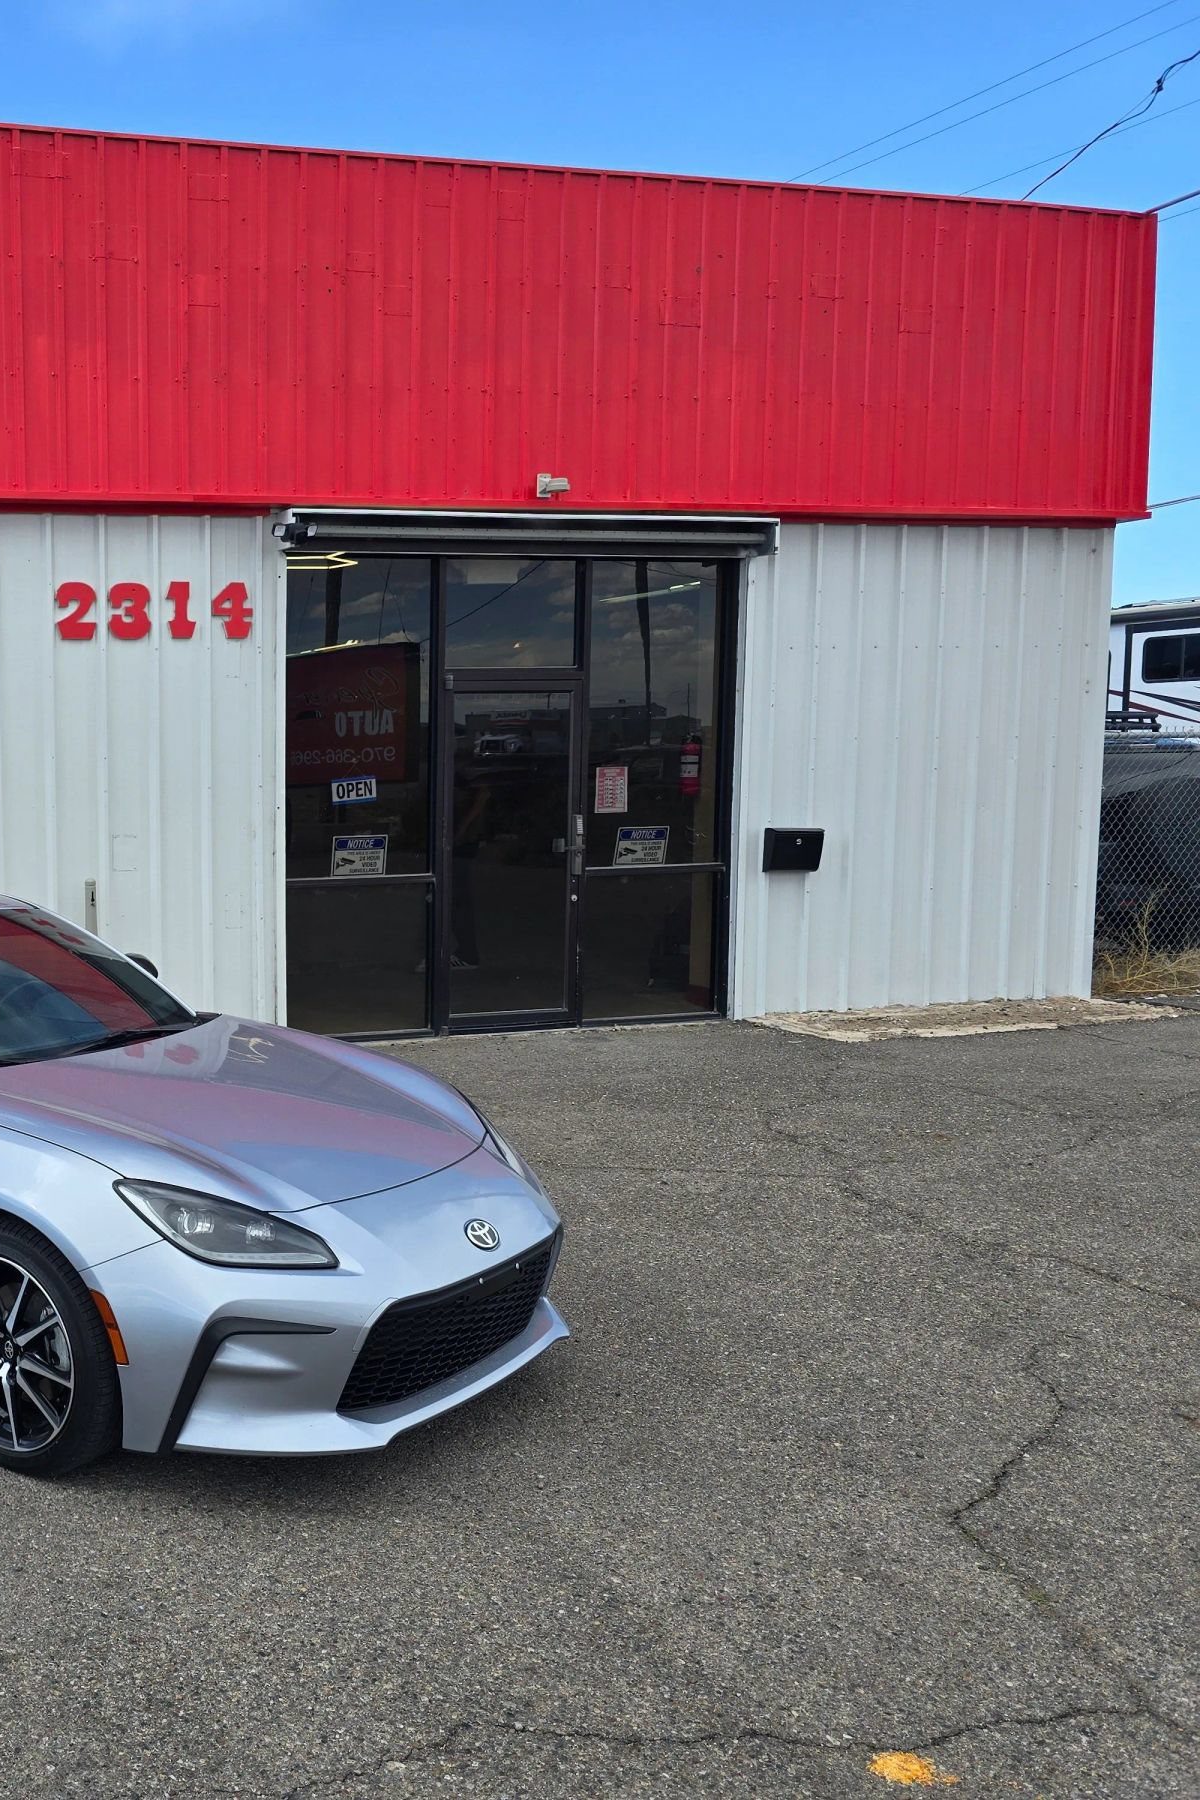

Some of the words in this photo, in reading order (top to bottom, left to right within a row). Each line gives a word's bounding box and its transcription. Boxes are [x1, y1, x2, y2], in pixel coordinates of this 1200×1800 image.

[54, 581, 254, 640] 2314
[336, 780, 373, 799] OPEN
[630, 830, 657, 839] NOTICE
[346, 839, 375, 849] NOTICE
